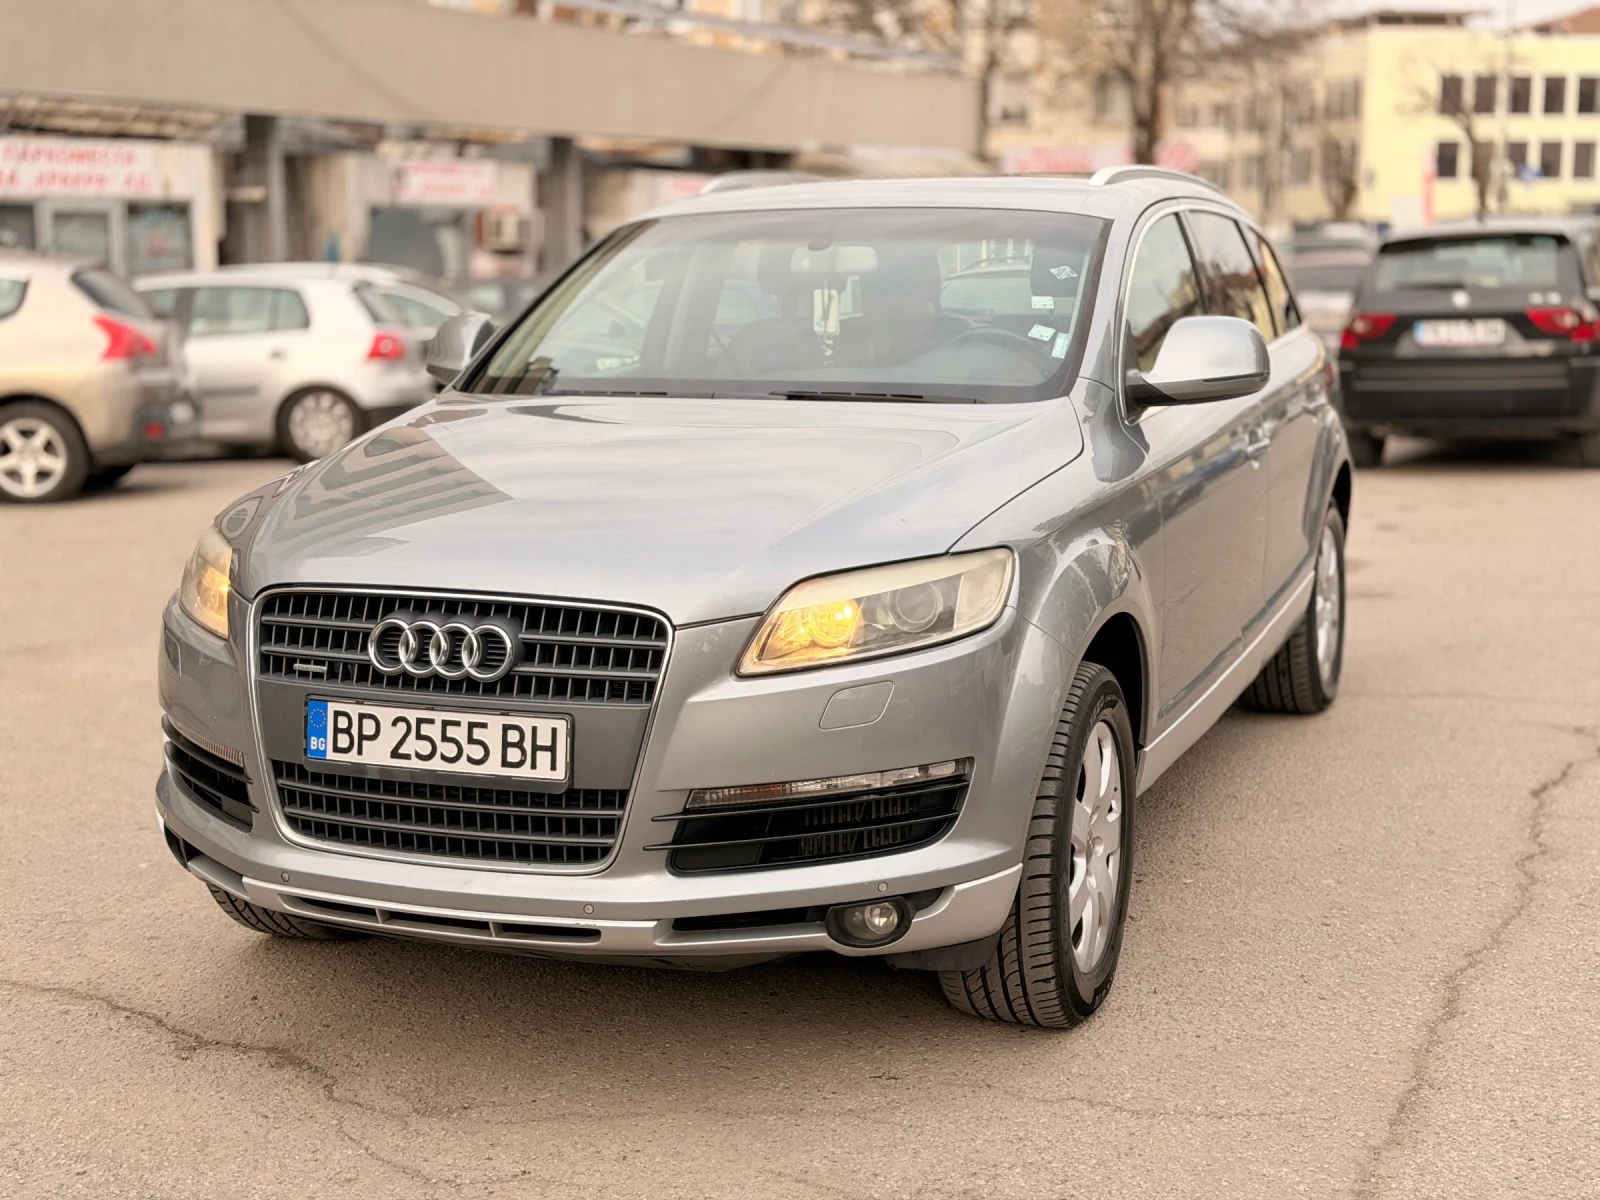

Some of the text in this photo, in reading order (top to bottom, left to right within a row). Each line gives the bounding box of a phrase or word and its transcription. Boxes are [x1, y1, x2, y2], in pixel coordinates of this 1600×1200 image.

[310, 736, 326, 751] BG
[332, 709, 558, 772] BP 2555 BH
